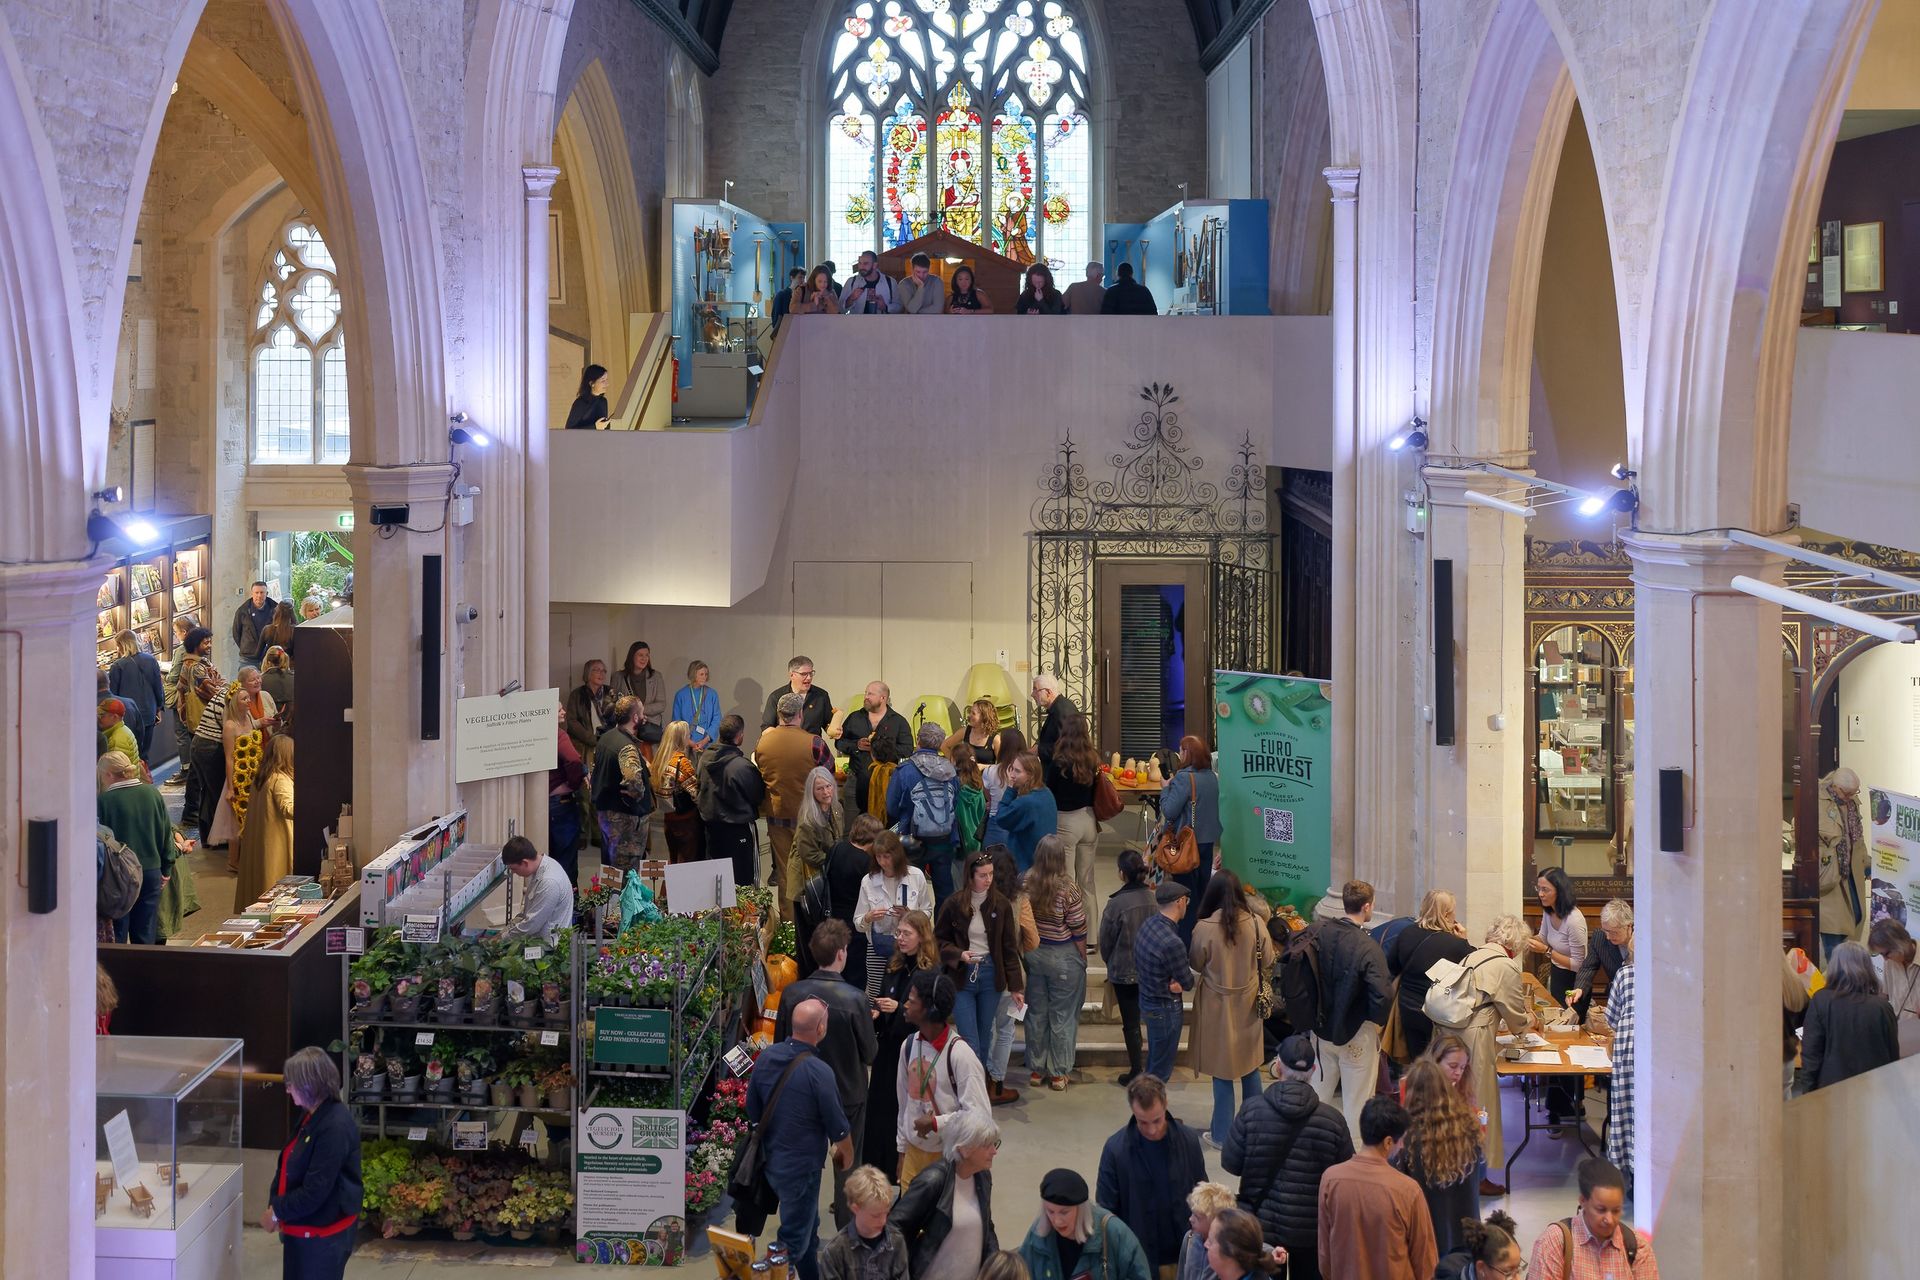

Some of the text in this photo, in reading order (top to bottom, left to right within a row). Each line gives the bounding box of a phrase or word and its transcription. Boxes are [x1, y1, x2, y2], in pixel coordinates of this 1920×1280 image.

[465, 708, 551, 724] VEGELICIOUS NURSERY
[1261, 738, 1292, 757] EURO
[1244, 754, 1313, 780] HARVEST
[1274, 851, 1297, 860] MAKE
[1276, 861, 1310, 872] DREAMS
[1258, 868, 1301, 880] COME TRUE
